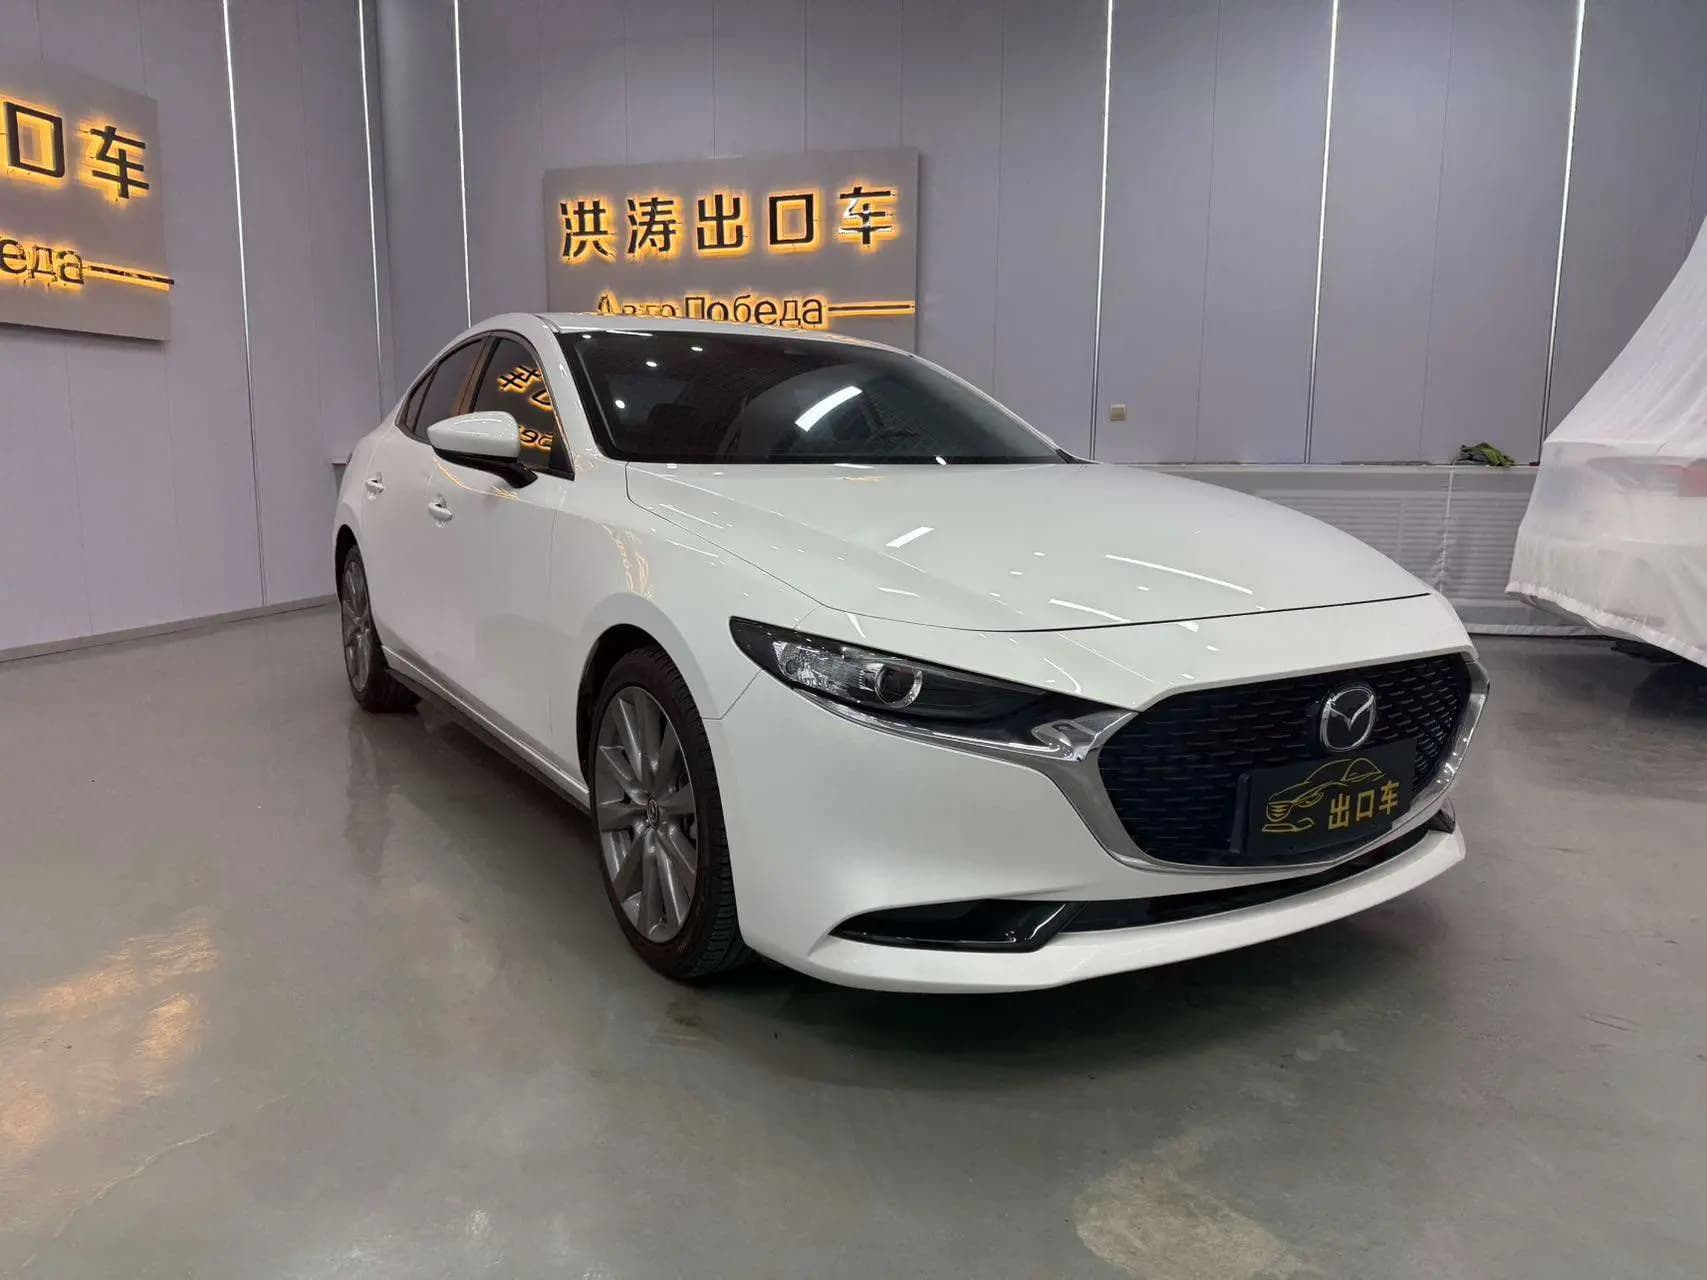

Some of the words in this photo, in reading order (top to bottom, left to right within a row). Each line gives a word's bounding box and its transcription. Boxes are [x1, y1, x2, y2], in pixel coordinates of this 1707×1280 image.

[558, 185, 893, 257] 洪涛出口车
[1327, 780, 1400, 830] 出口车
